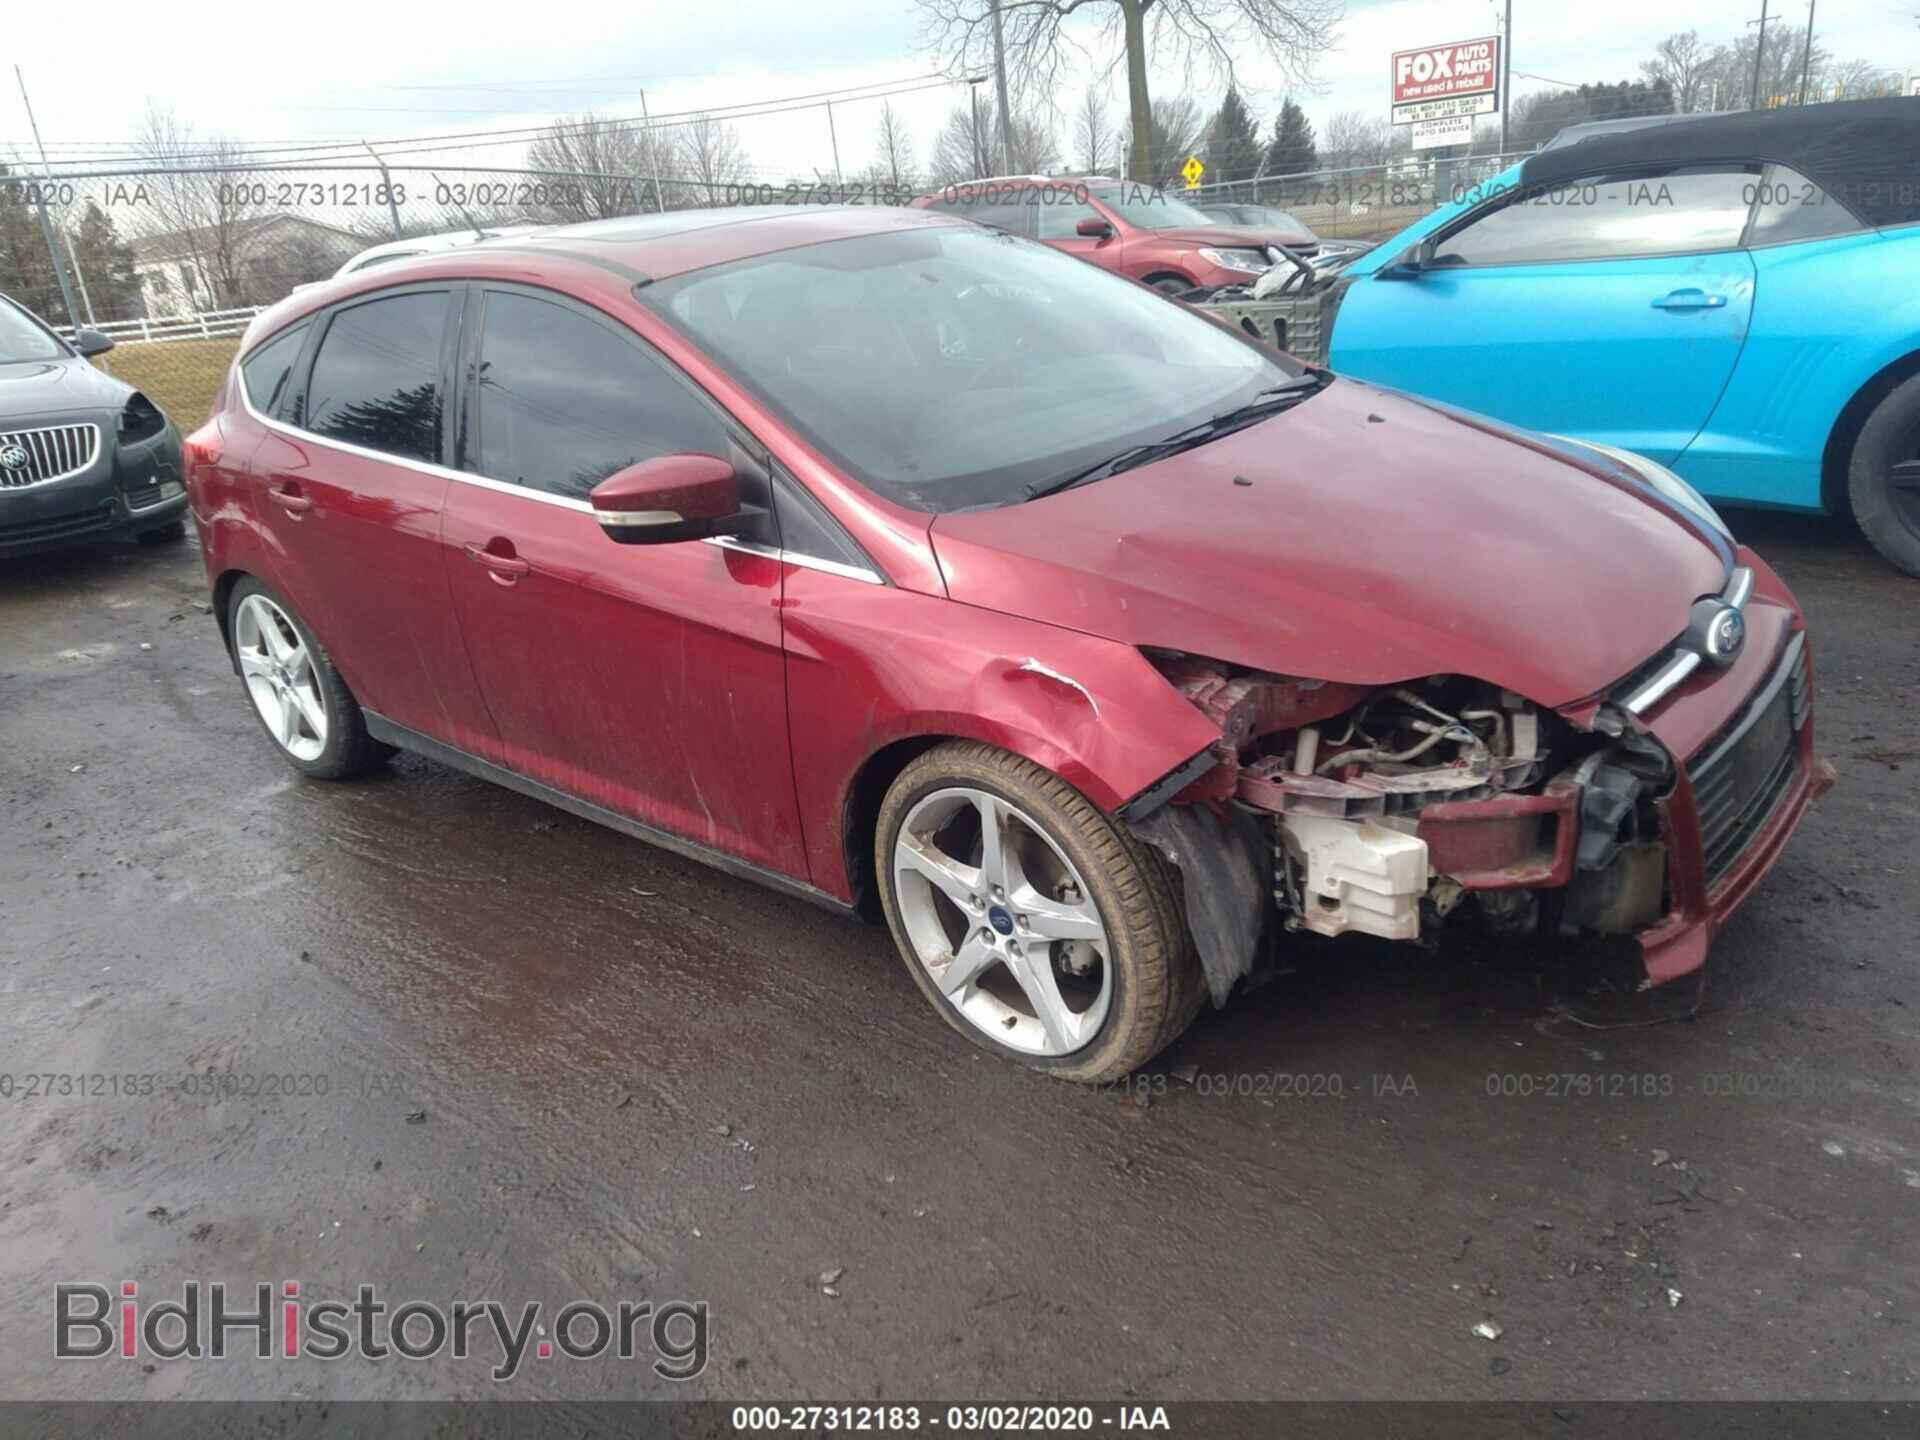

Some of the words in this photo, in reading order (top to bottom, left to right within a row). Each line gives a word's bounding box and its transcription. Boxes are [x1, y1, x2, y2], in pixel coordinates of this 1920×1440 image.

[1456, 44, 1488, 61] AUTO
[1397, 48, 1454, 85] FOX
[1455, 58, 1492, 76] PARTS
[1403, 86, 1421, 97] new
[1423, 81, 1445, 95] used
[1446, 80, 1453, 91] &
